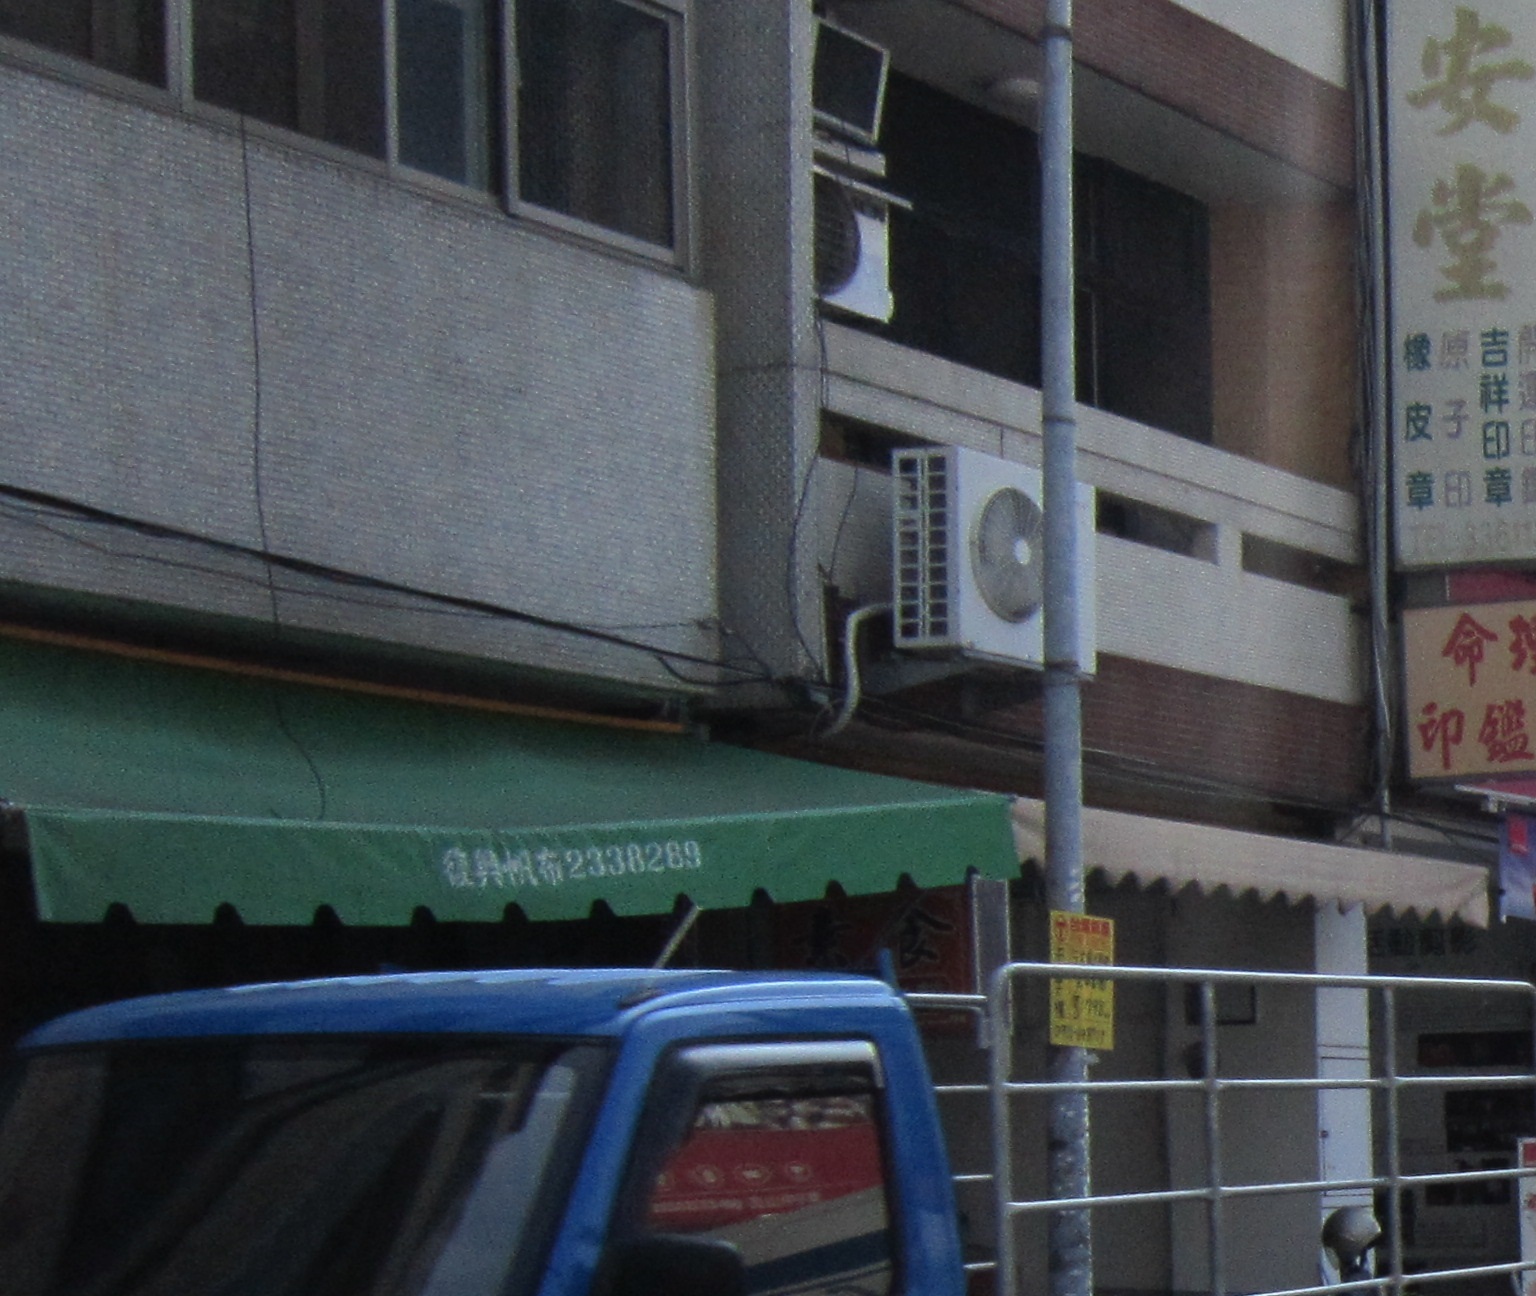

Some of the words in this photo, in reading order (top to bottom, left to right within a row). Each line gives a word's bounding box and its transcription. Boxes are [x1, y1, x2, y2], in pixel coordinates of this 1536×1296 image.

[1406, 8, 1536, 302] 安堂
[1404, 332, 1436, 511] 橡皮章
[1480, 327, 1513, 507] 吉祥印章
[1417, 699, 1536, 769] 印鑑
